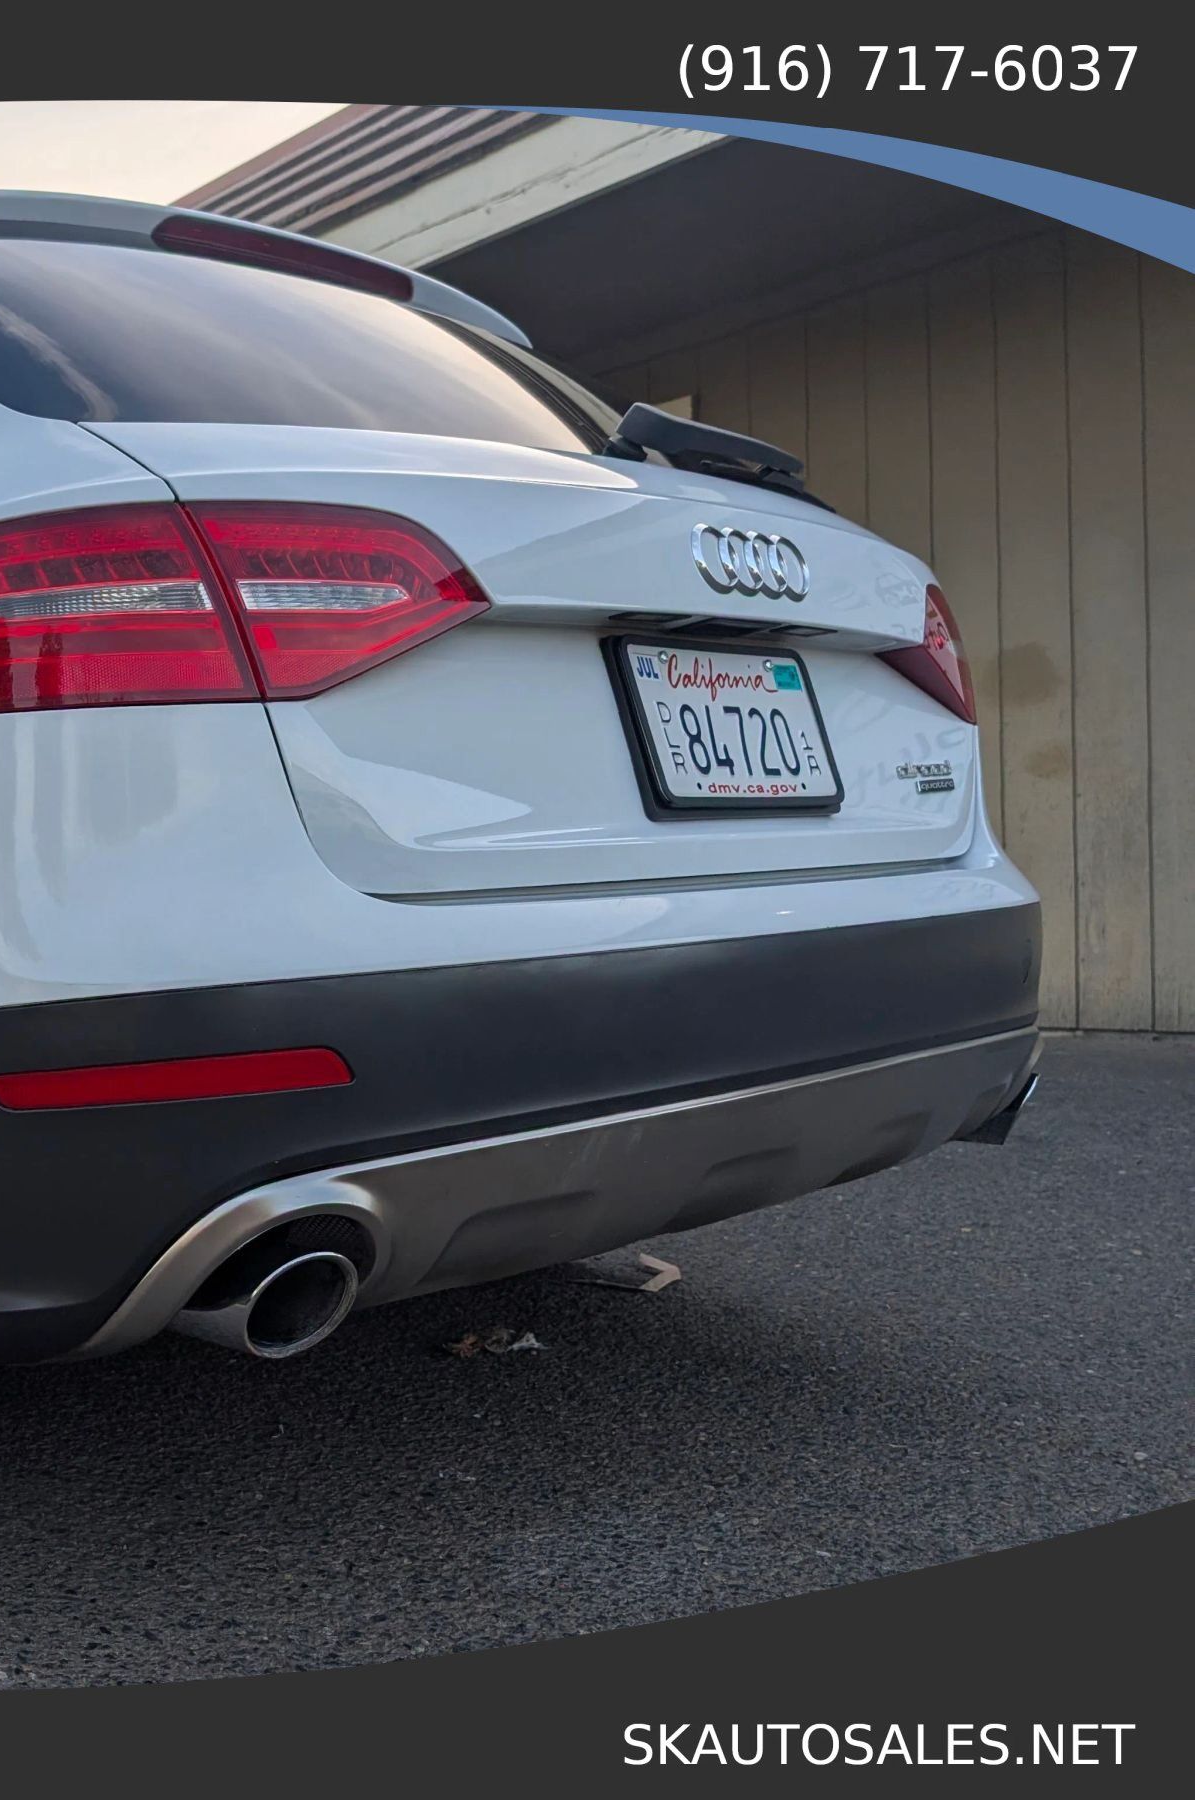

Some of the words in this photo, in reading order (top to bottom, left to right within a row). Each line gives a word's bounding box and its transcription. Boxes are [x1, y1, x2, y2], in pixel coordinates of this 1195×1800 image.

[636, 655, 660, 680] JUL
[667, 653, 779, 702] California
[679, 703, 801, 776] 84720
[707, 782, 798, 795] dmv.ca.gov
